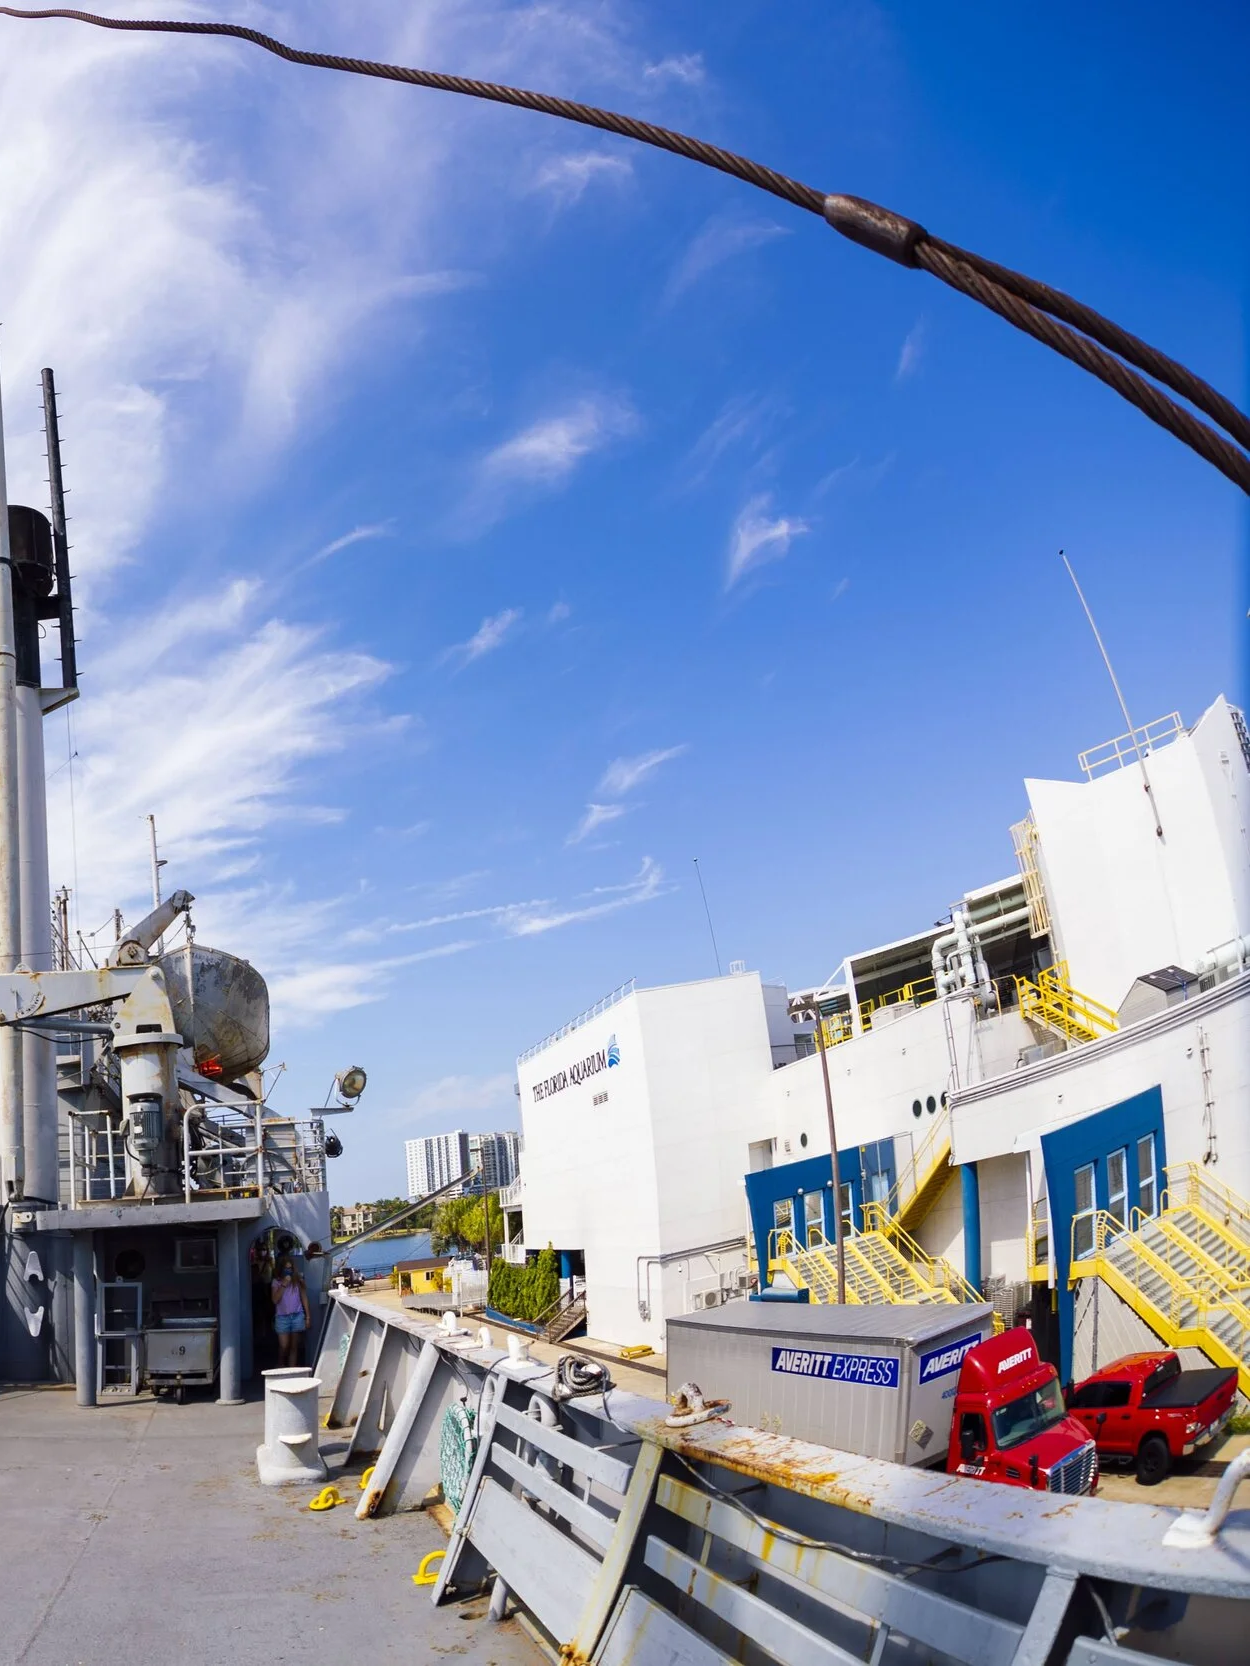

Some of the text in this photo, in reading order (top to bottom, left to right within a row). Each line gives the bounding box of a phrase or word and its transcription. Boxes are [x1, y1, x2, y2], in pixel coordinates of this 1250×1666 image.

[532, 1049, 607, 1102] THE FLORIDA AQUARIUM
[775, 1350, 894, 1384] AVERITT EXPRESS
[997, 1347, 1032, 1375] AVERITT
